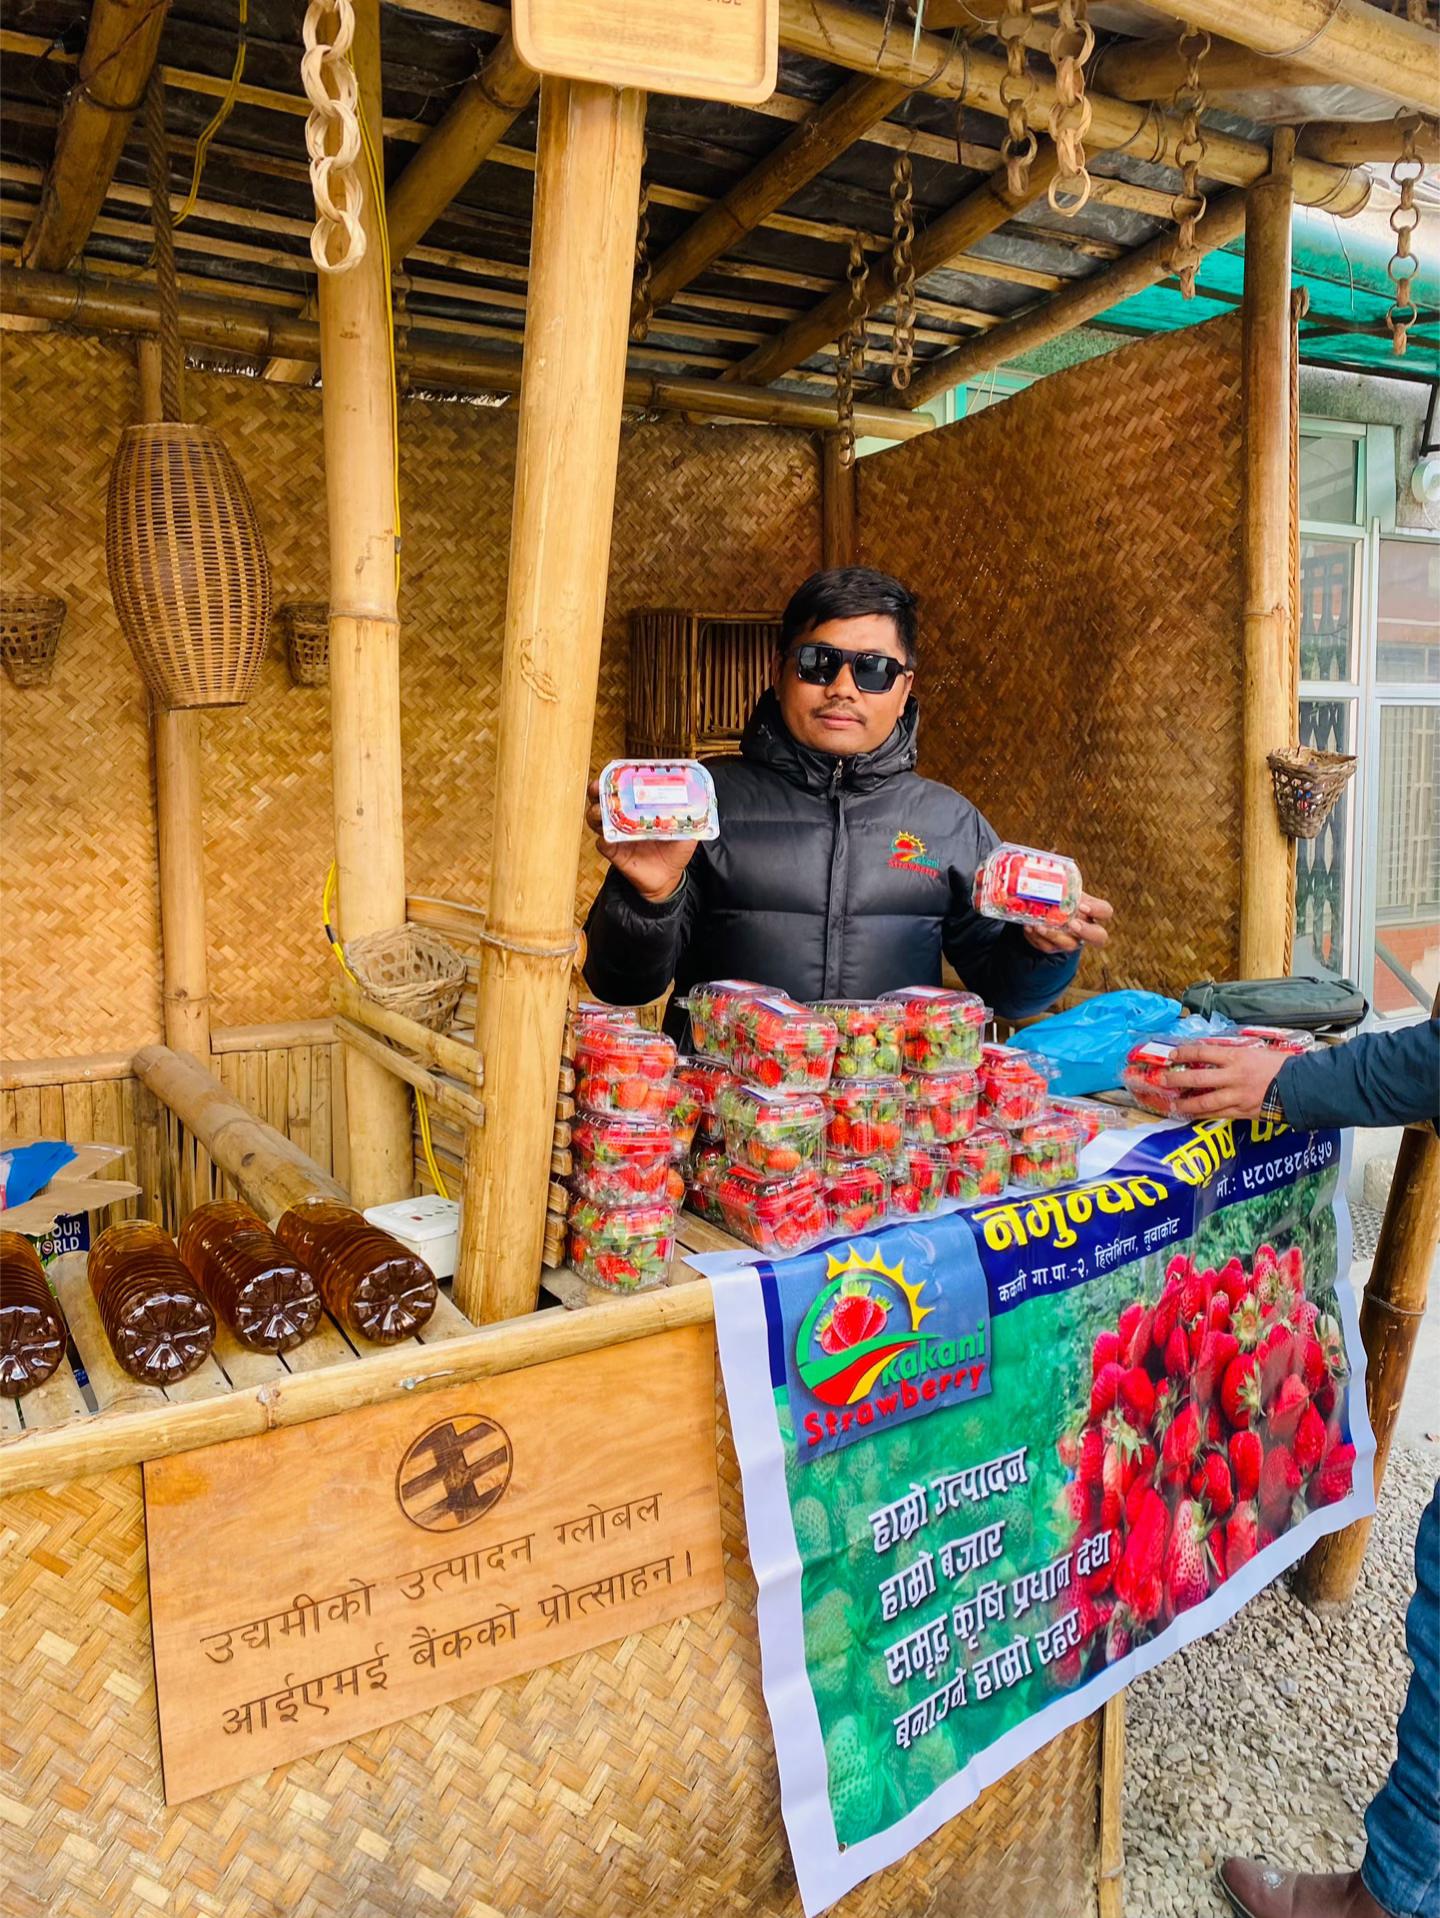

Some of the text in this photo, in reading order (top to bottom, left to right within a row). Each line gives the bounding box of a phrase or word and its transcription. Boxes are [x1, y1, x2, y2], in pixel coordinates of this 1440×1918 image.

[803, 1363, 986, 1446] Strawberry
[868, 1446, 1029, 1553] हाम्रो उत्पादन
[200, 1491, 663, 1664] उद्यमीको उत्पादन ग्लोबल
[878, 1520, 1006, 1621] हाम्रो बजार
[952, 1579, 1006, 1650] कृषि
[1011, 1552, 1073, 1618] प्रधान
[1076, 1529, 1113, 1576] देश
[222, 1641, 390, 1736] आईएमई
[409, 1602, 521, 1669] बैंकको
[893, 1607, 1083, 1749] बनाउने हाम्रो रहर
